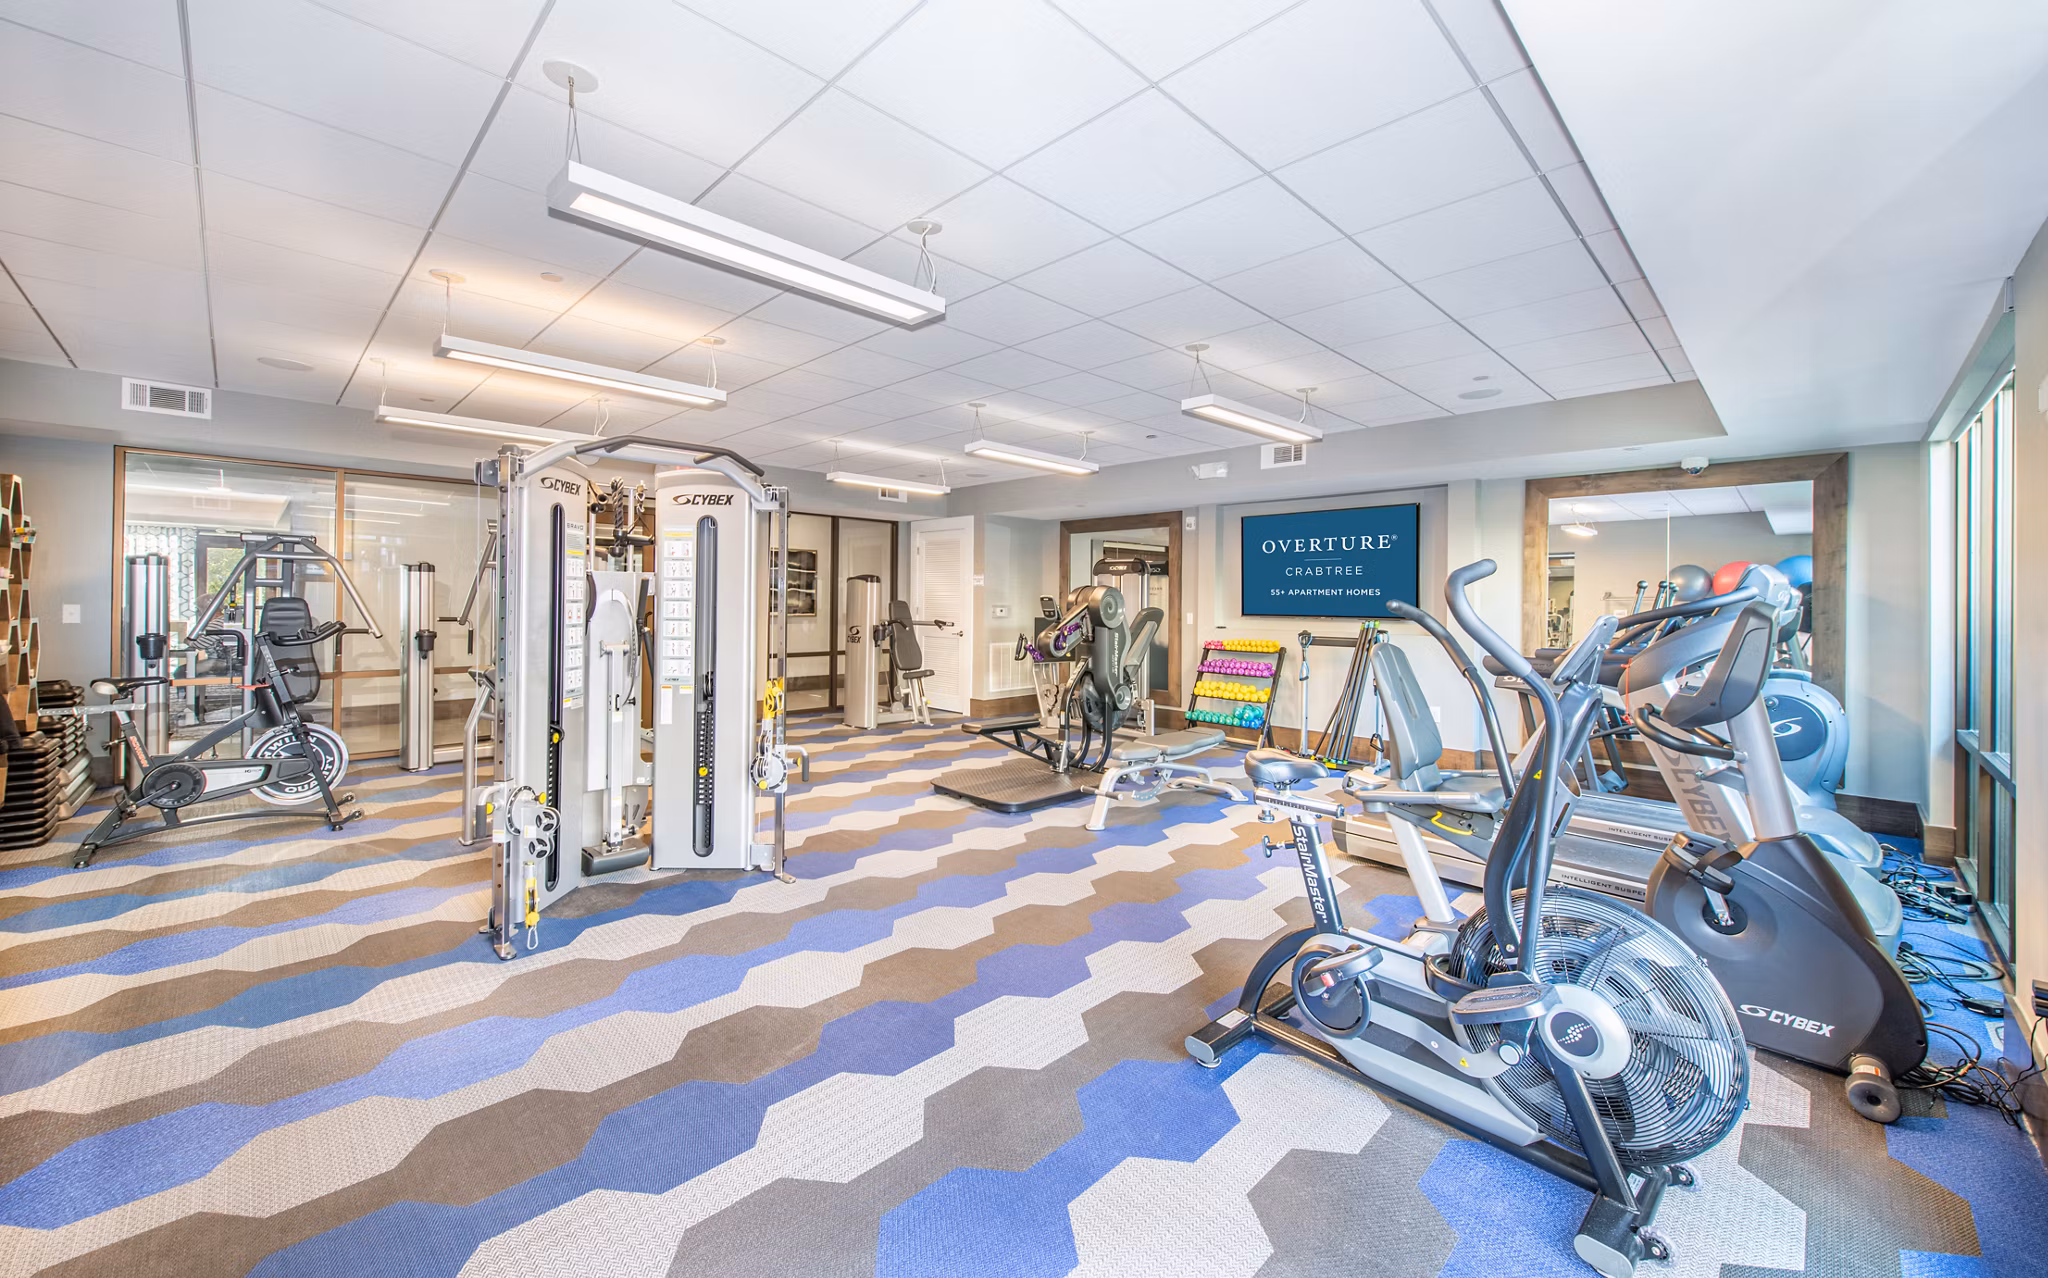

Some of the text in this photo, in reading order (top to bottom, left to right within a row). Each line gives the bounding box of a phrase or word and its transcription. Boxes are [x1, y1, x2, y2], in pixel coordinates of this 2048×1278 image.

[553, 478, 581, 496] CYBEX
[691, 494, 735, 506] CYBEX
[1285, 565, 1364, 577] CRABTREE
[1270, 588, 1381, 596] 55+ APARTMENT HOMES
[284, 755, 334, 793] QUAITY
[1608, 827, 1652, 838] INTELLIGENT
[1293, 825, 1327, 920] StairMaster
[1561, 874, 1612, 889] INTELLIGENT
[1768, 1010, 1835, 1037] CYBEX
